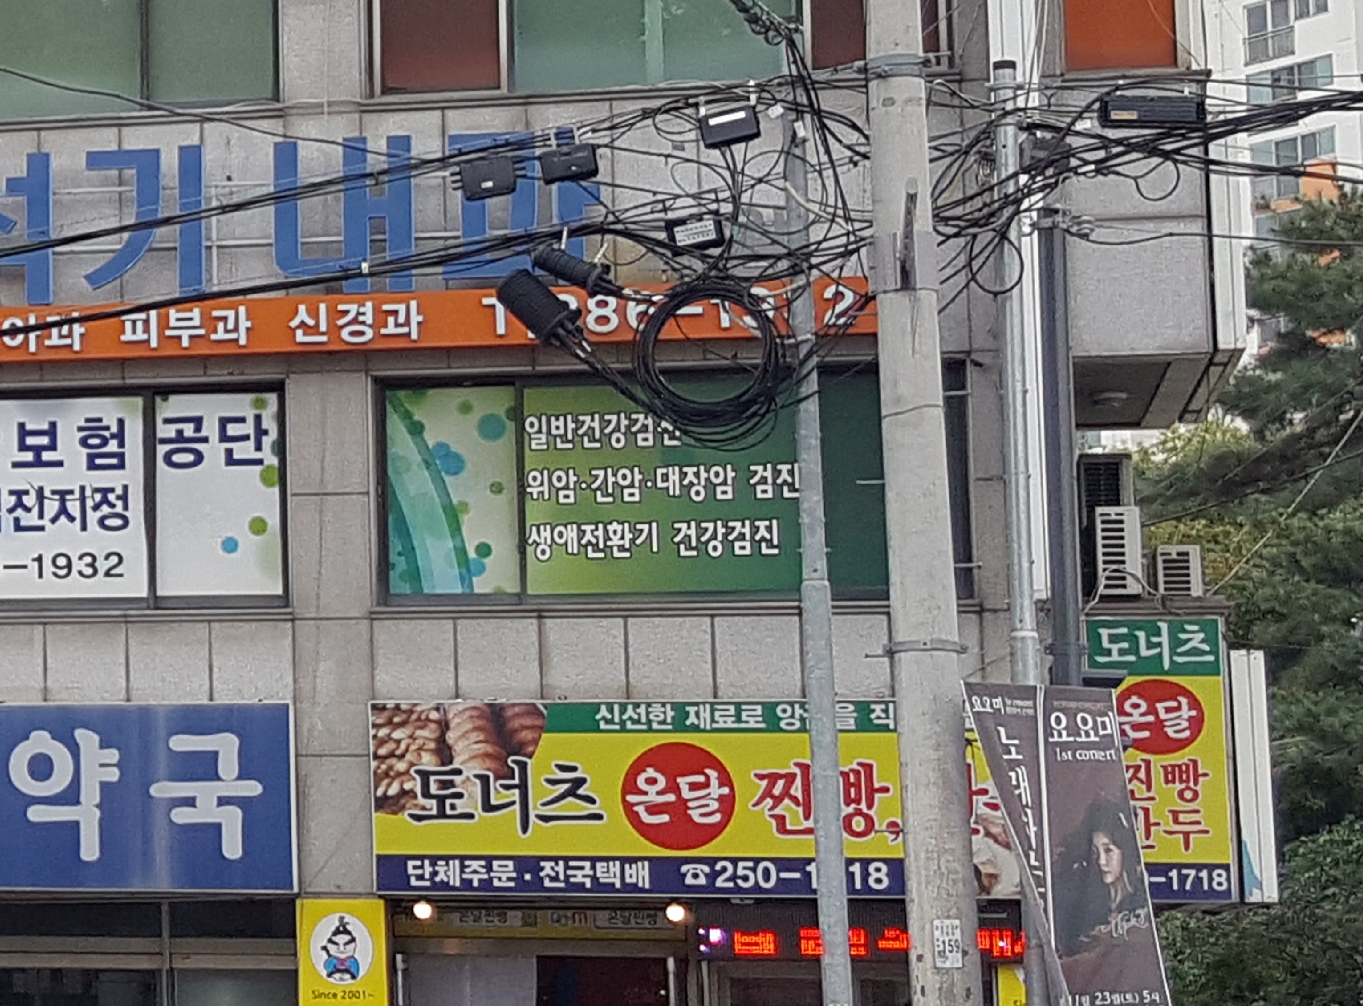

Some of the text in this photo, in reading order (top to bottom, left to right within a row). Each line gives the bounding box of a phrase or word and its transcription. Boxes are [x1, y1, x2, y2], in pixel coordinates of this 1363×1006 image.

[120, 305, 251, 349] 피부과
[289, 300, 423, 344] 신경과
[156, 412, 269, 469] 공단
[749, 463, 800, 499] 검진
[527, 519, 780, 561] 생애전환기 건강검진
[1094, 620, 1216, 670] 도너츠
[596, 703, 675, 730] 신선한
[684, 703, 766, 729] 재료로
[1117, 695, 1197, 739] 온달
[405, 755, 606, 838] 도너츠
[625, 767, 730, 824] 온달
